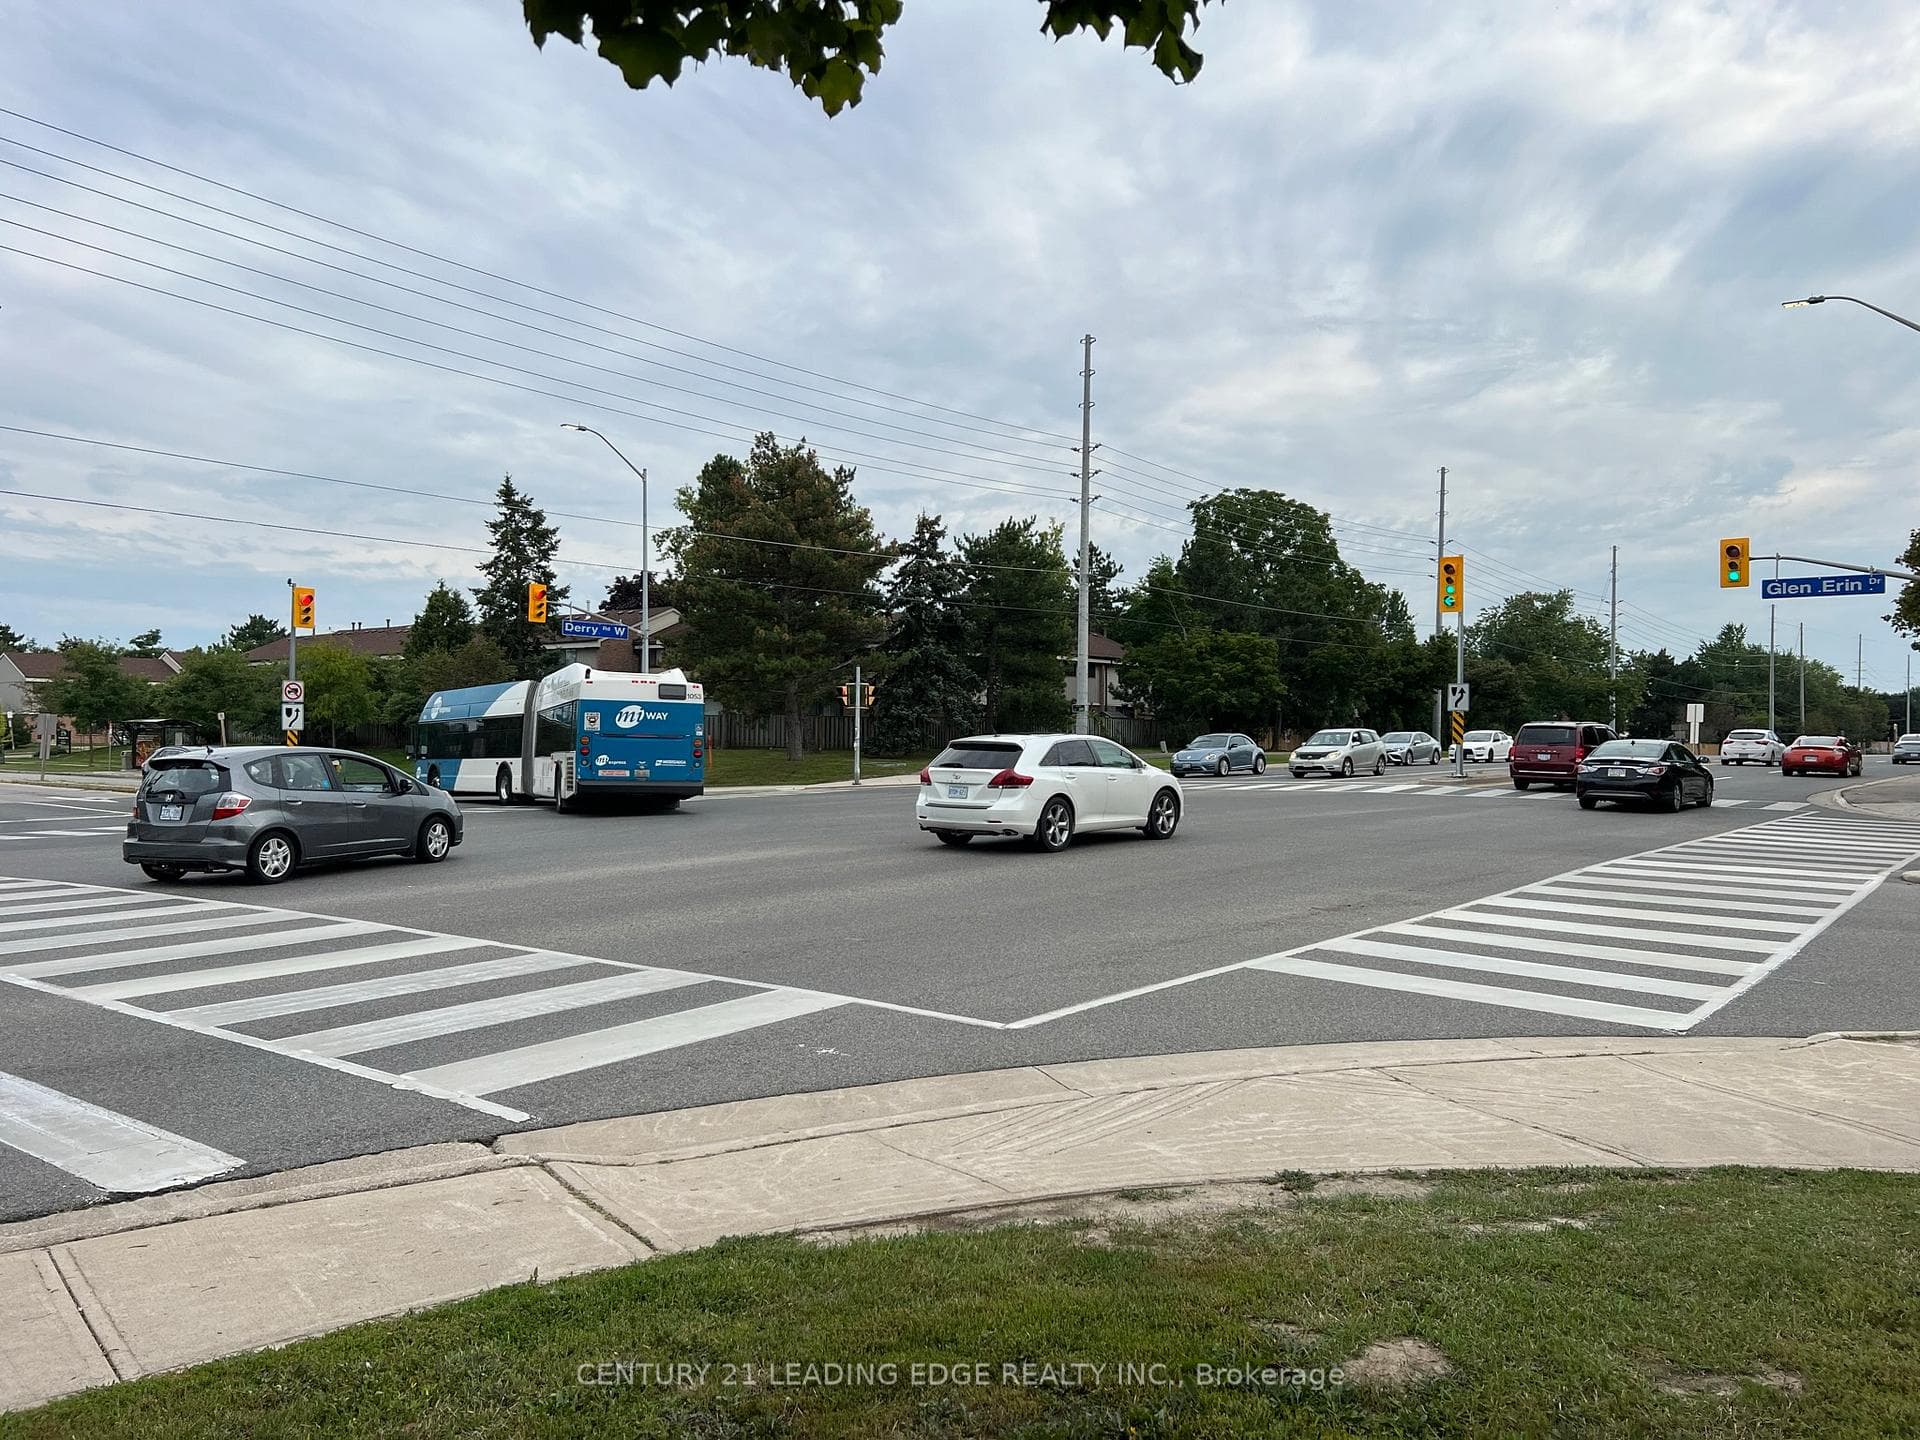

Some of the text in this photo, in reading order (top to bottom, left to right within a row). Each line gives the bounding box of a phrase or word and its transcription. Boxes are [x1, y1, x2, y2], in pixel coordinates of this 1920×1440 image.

[1766, 577, 1881, 595] Glen Erin Dr
[564, 622, 599, 635] Derry
[614, 626, 626, 636] W
